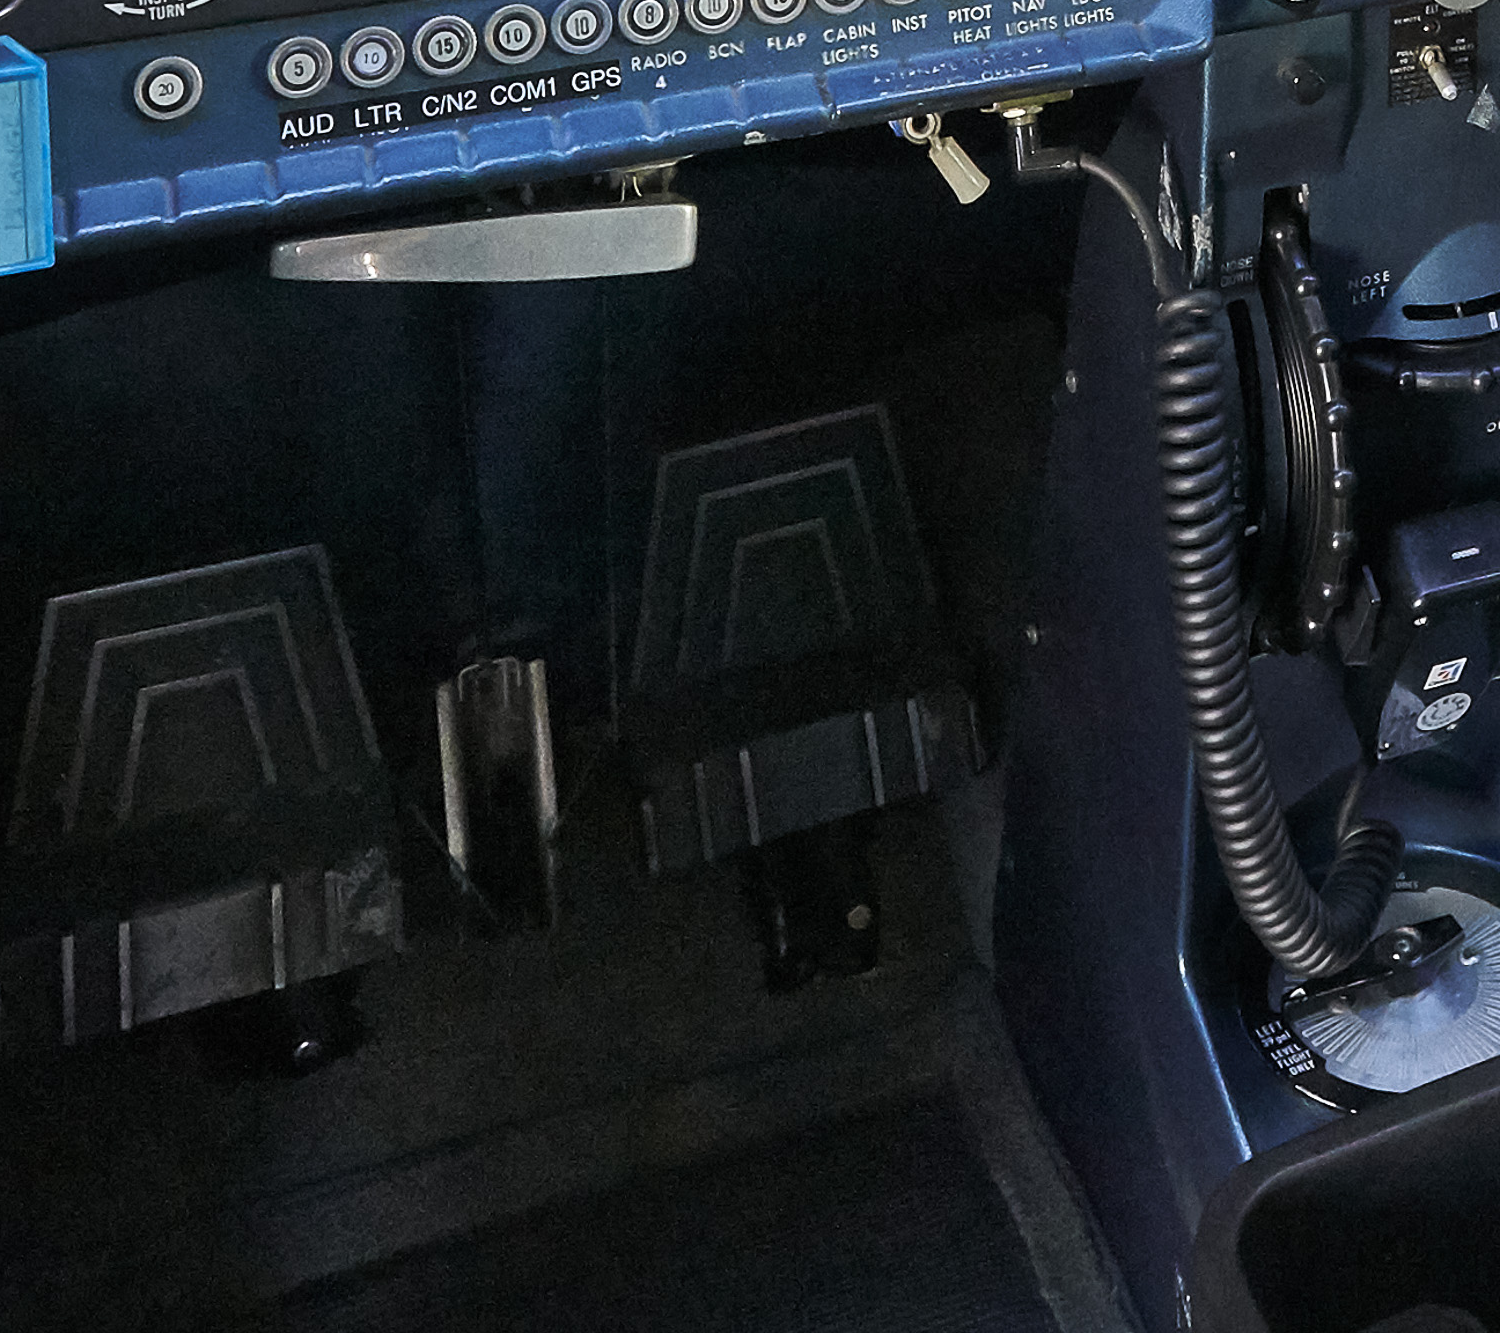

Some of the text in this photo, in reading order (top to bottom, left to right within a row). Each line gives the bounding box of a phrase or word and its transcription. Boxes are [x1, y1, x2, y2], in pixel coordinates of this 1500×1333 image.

[147, 2, 186, 20] TURN
[947, 4, 993, 23] PITOT
[1063, 7, 1115, 28] LIGHTS
[891, 13, 928, 32] INST
[1005, 16, 1058, 36] LIGHTS
[767, 32, 807, 51] FLAP
[822, 23, 877, 45] CABIN
[952, 25, 992, 45] HEAT
[630, 50, 686, 72] RADIO
[822, 44, 880, 64] LIGHTS
[280, 67, 623, 140] AUD LTR C/N2 COM1 GPS
[1347, 269, 1391, 290] NOSE
[1351, 286, 1387, 305] LEFT
[1276, 1049, 1313, 1070] FLIGHT
